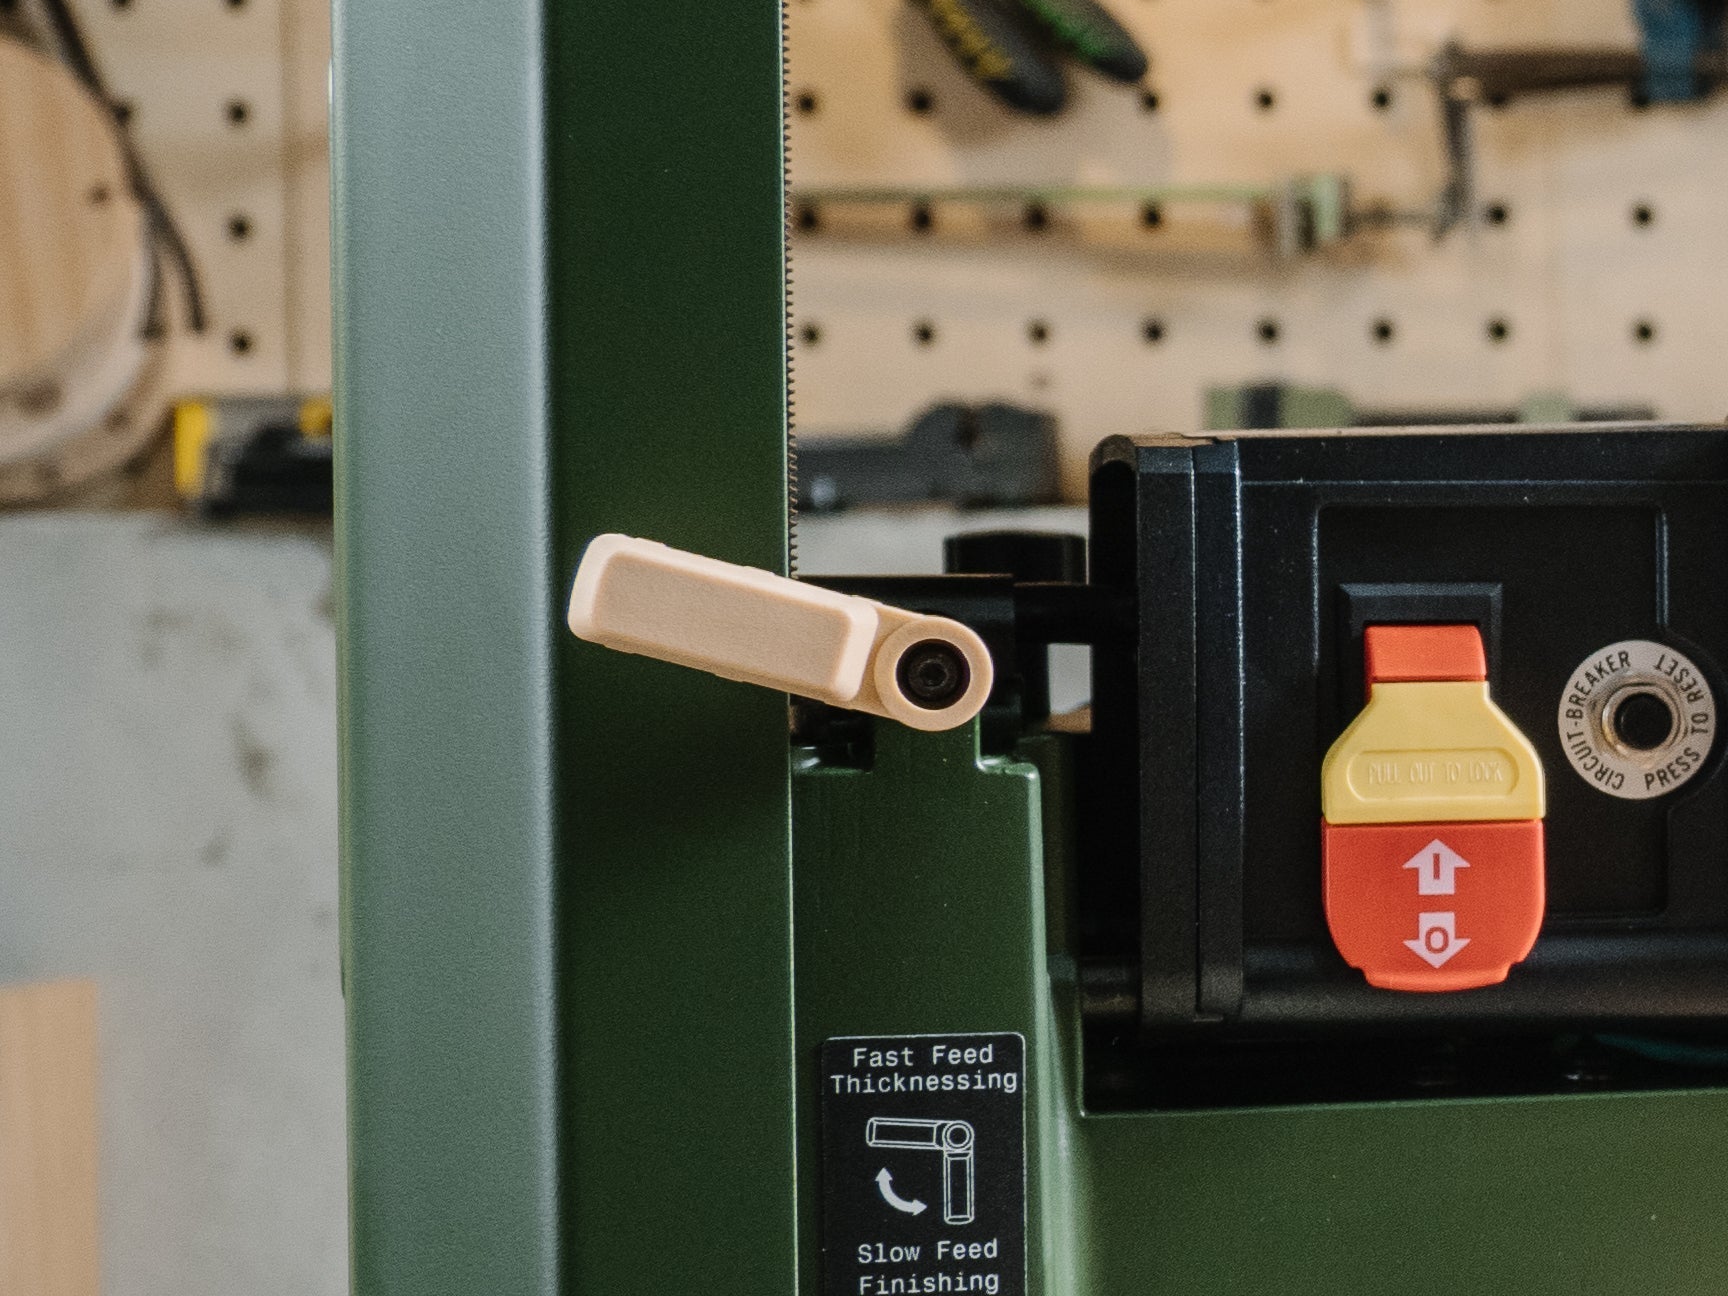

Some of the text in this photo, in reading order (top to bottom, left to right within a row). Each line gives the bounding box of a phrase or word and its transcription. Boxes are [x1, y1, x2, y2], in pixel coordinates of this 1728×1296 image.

[1565, 650, 1631, 791] CIRCUIT-BREAKER
[1644, 654, 1709, 791] PRESS TO RESET
[852, 1044, 994, 1068] Fast Feed
[830, 1071, 1018, 1094] Thicknessing
[857, 1239, 998, 1264] Slow Feed
[859, 1272, 999, 1295] Finishing
